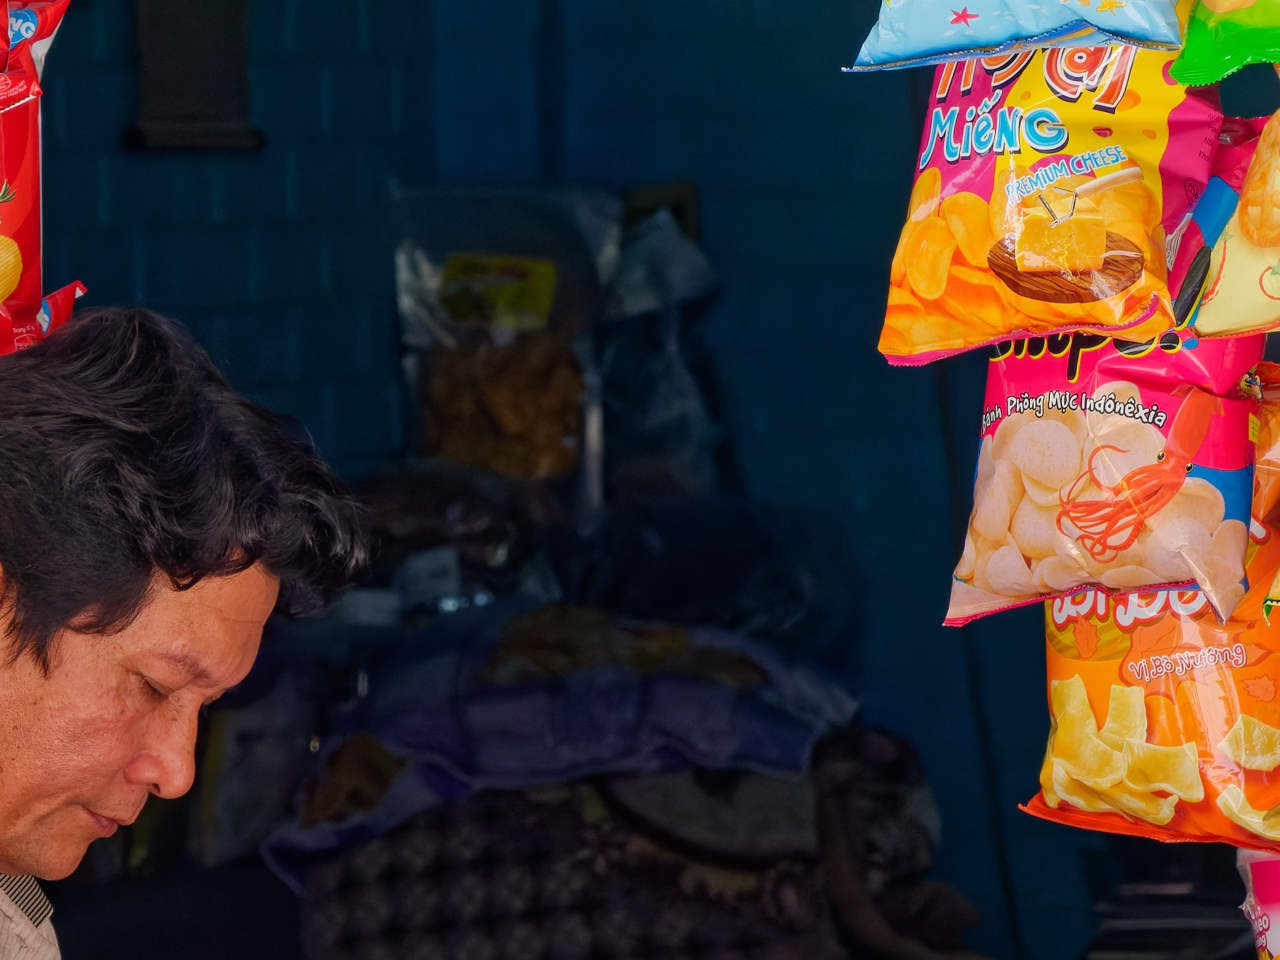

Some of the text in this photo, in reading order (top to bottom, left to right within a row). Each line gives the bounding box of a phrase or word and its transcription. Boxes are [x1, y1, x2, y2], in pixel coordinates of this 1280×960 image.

[1005, 144, 1128, 206] PREMIUM CHEESE
[1007, 393, 1045, 419] Phồng
[1048, 391, 1077, 413] Mực
[1081, 392, 1167, 429] Indônêxia
[1129, 644, 1247, 681] Vị Bò Nướng
